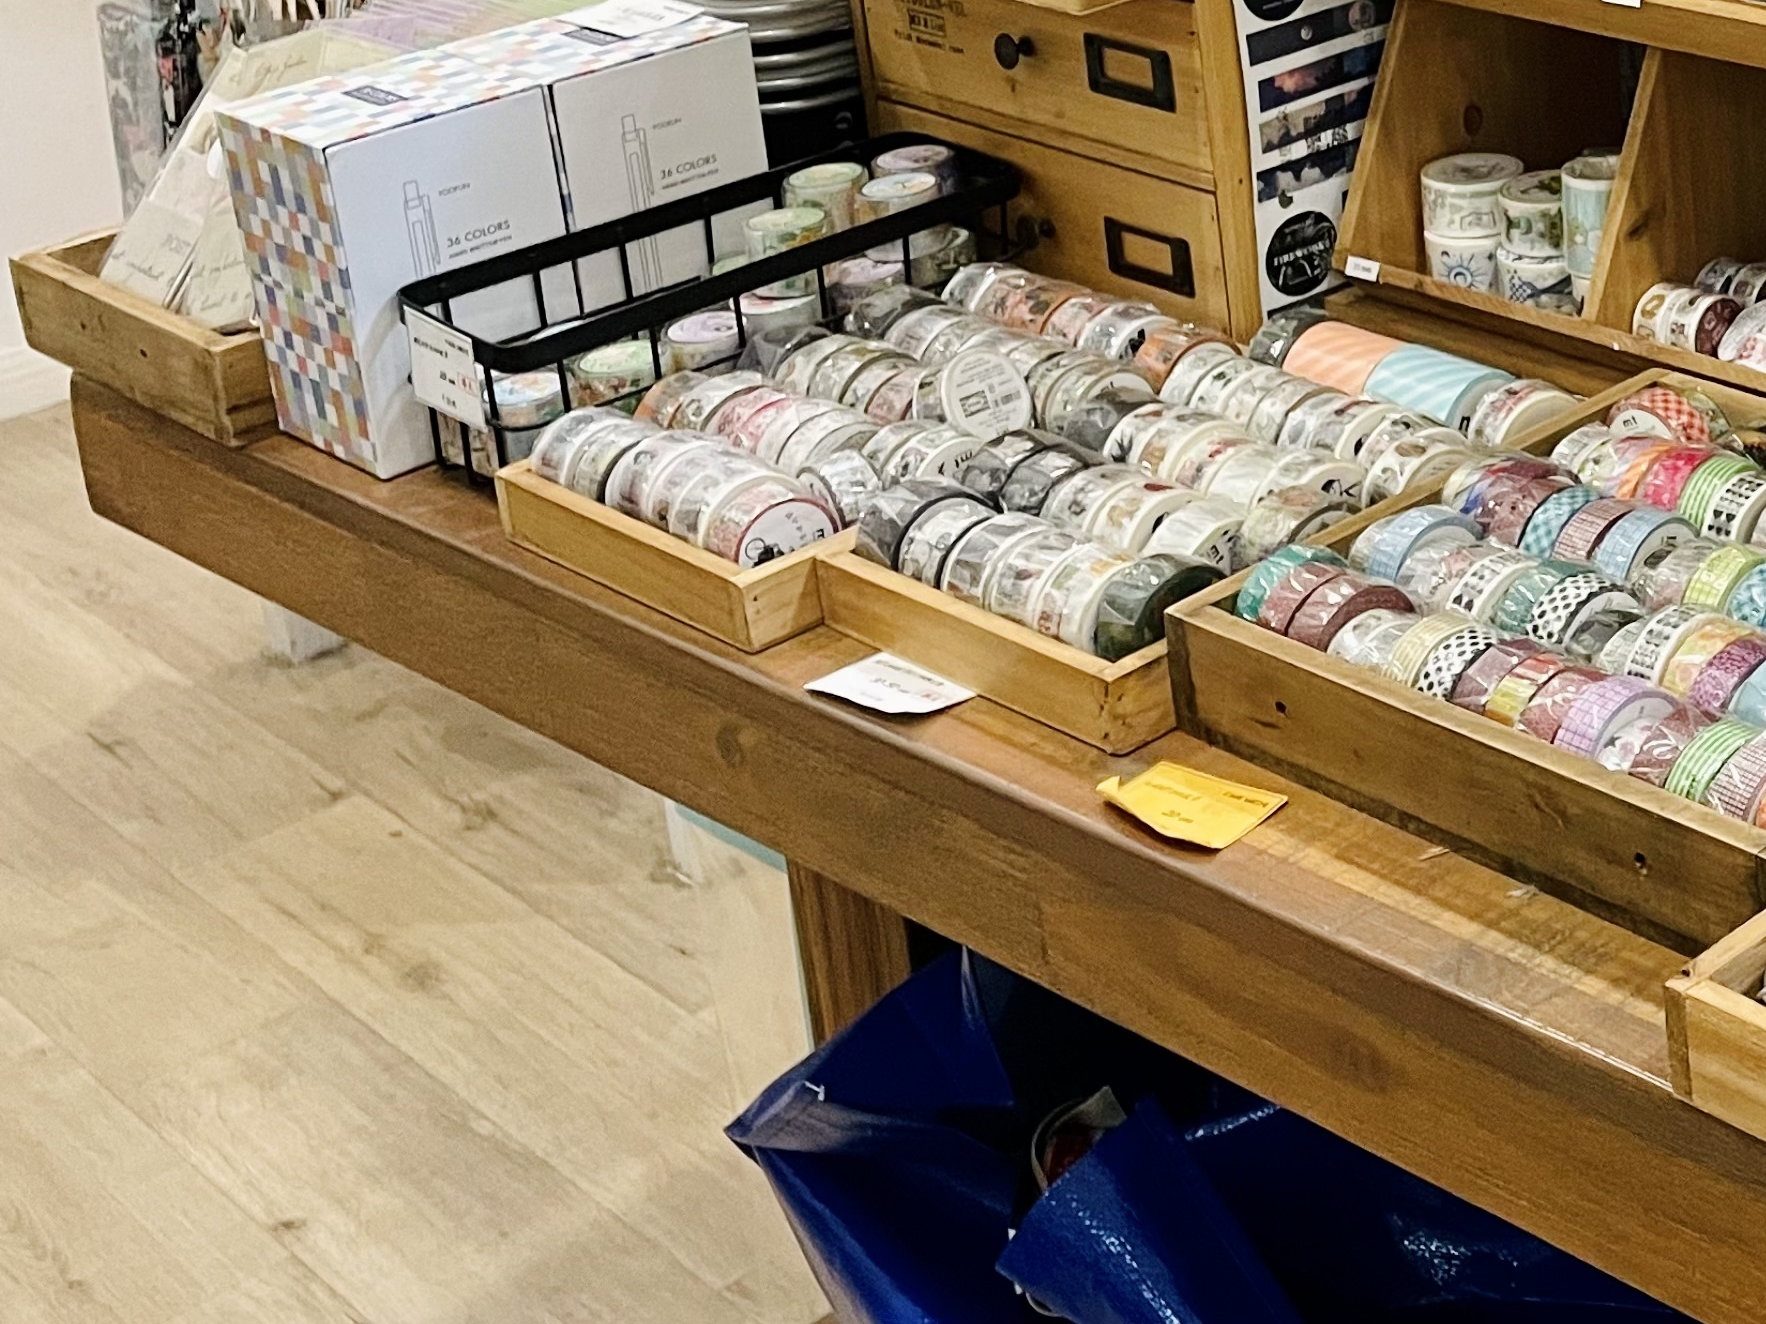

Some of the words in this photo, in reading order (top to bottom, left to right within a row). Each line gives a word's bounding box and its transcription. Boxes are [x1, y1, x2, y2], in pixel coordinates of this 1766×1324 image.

[660, 168, 674, 181] 36
[676, 153, 719, 174] COLORS
[447, 236, 462, 248] 36
[464, 219, 512, 243] COLORS
